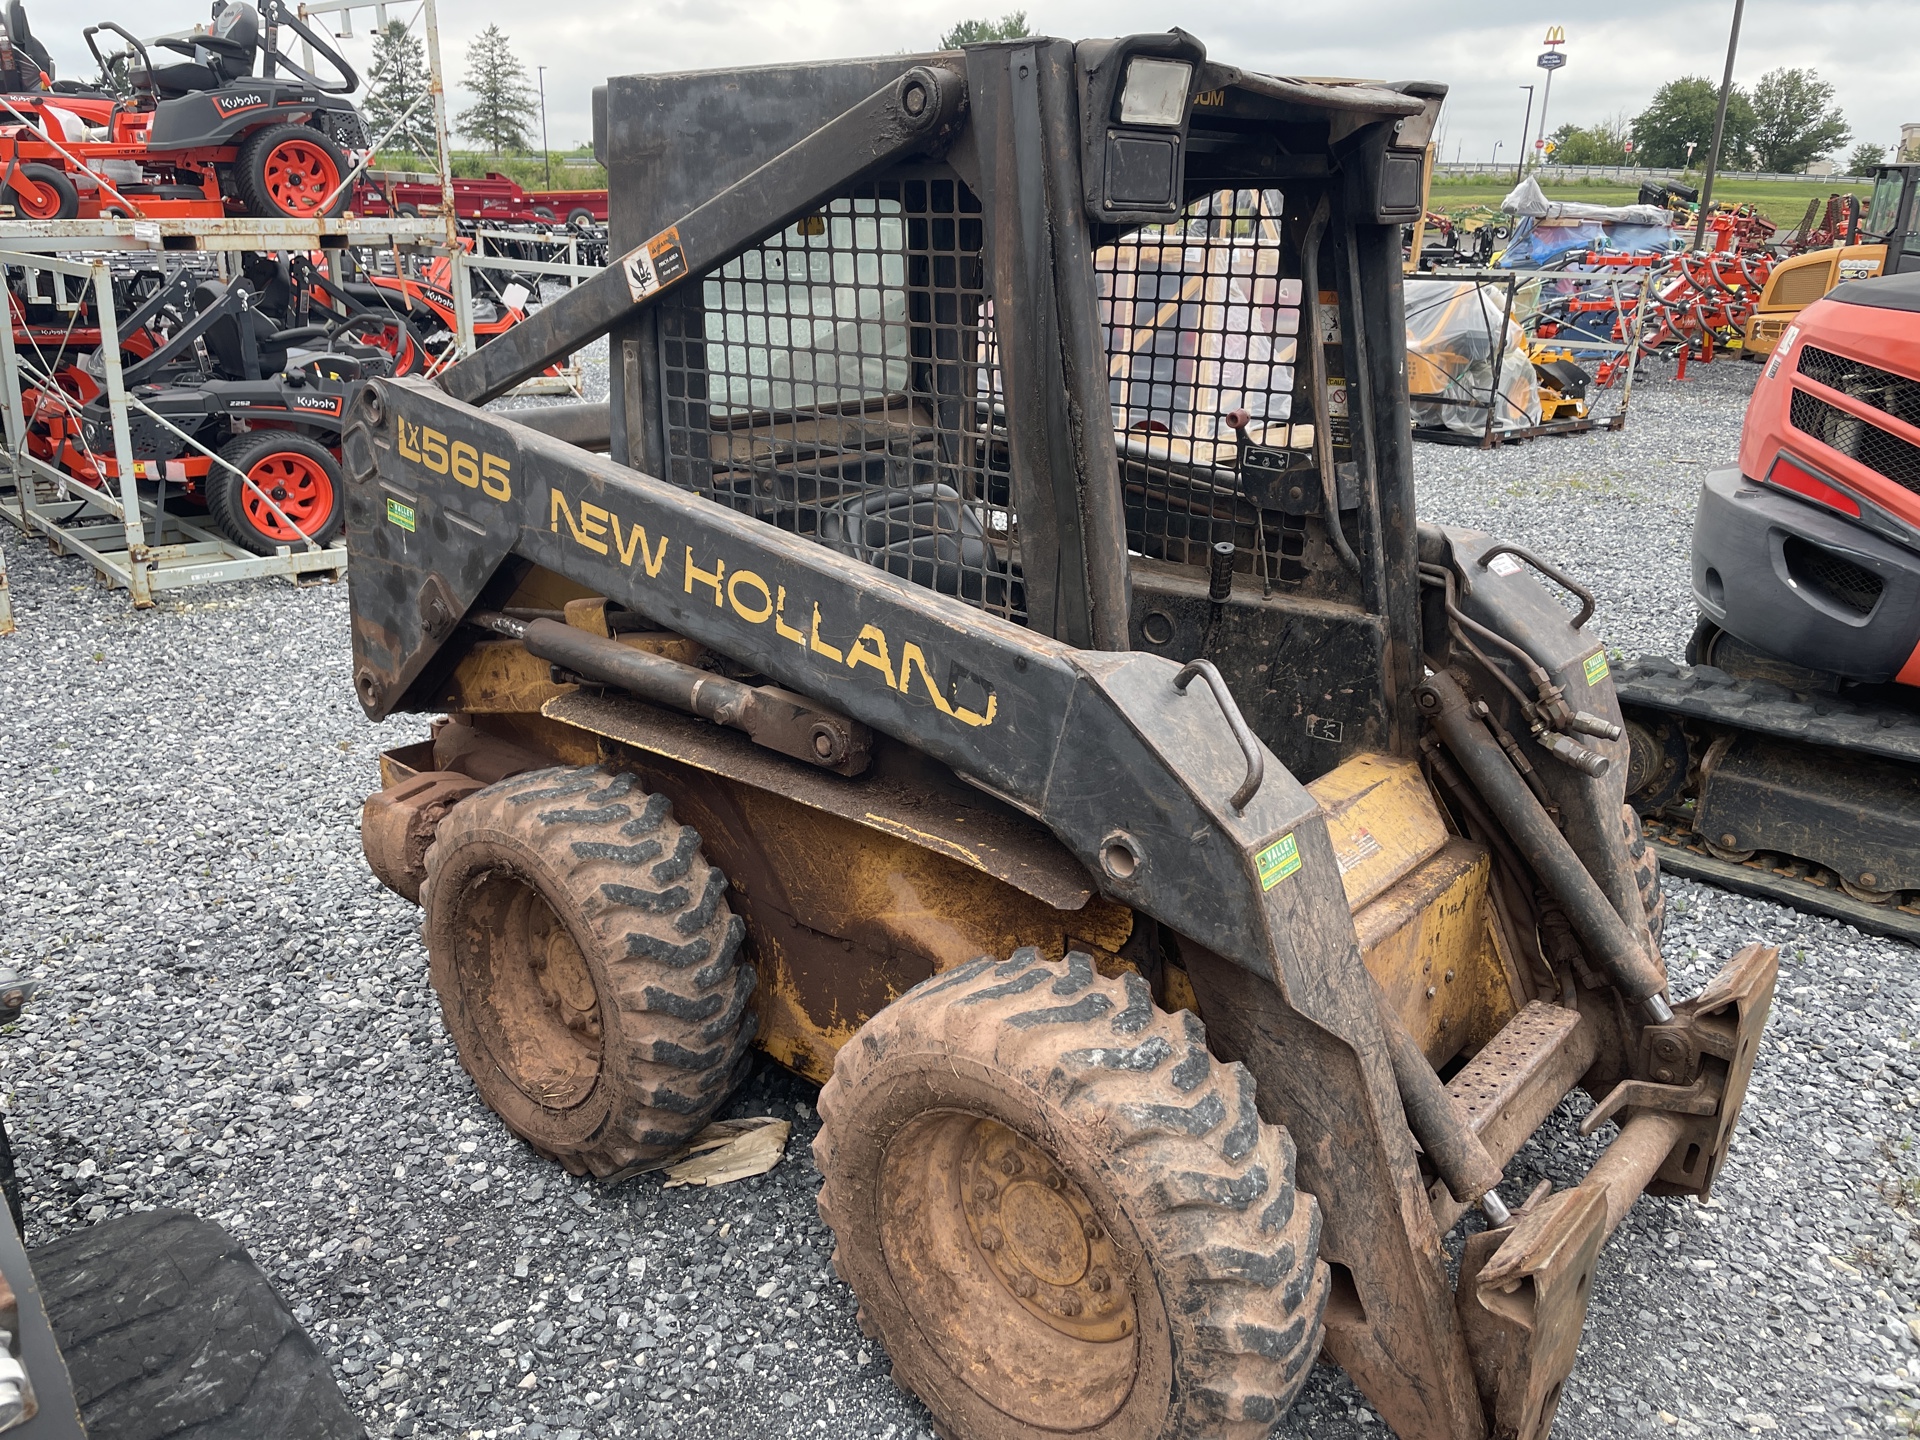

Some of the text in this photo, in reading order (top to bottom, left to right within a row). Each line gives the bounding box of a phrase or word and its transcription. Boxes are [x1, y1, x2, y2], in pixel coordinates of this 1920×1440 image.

[221, 93, 262, 109] Kubota
[1838, 259, 1881, 270] CASE
[427, 290, 454, 309] Kubota
[1329, 378, 1346, 386] CAUT
[297, 396, 336, 410] Kubota
[550, 487, 998, 728] NEW HOLLAND
[1266, 837, 1293, 863] VALLEY
